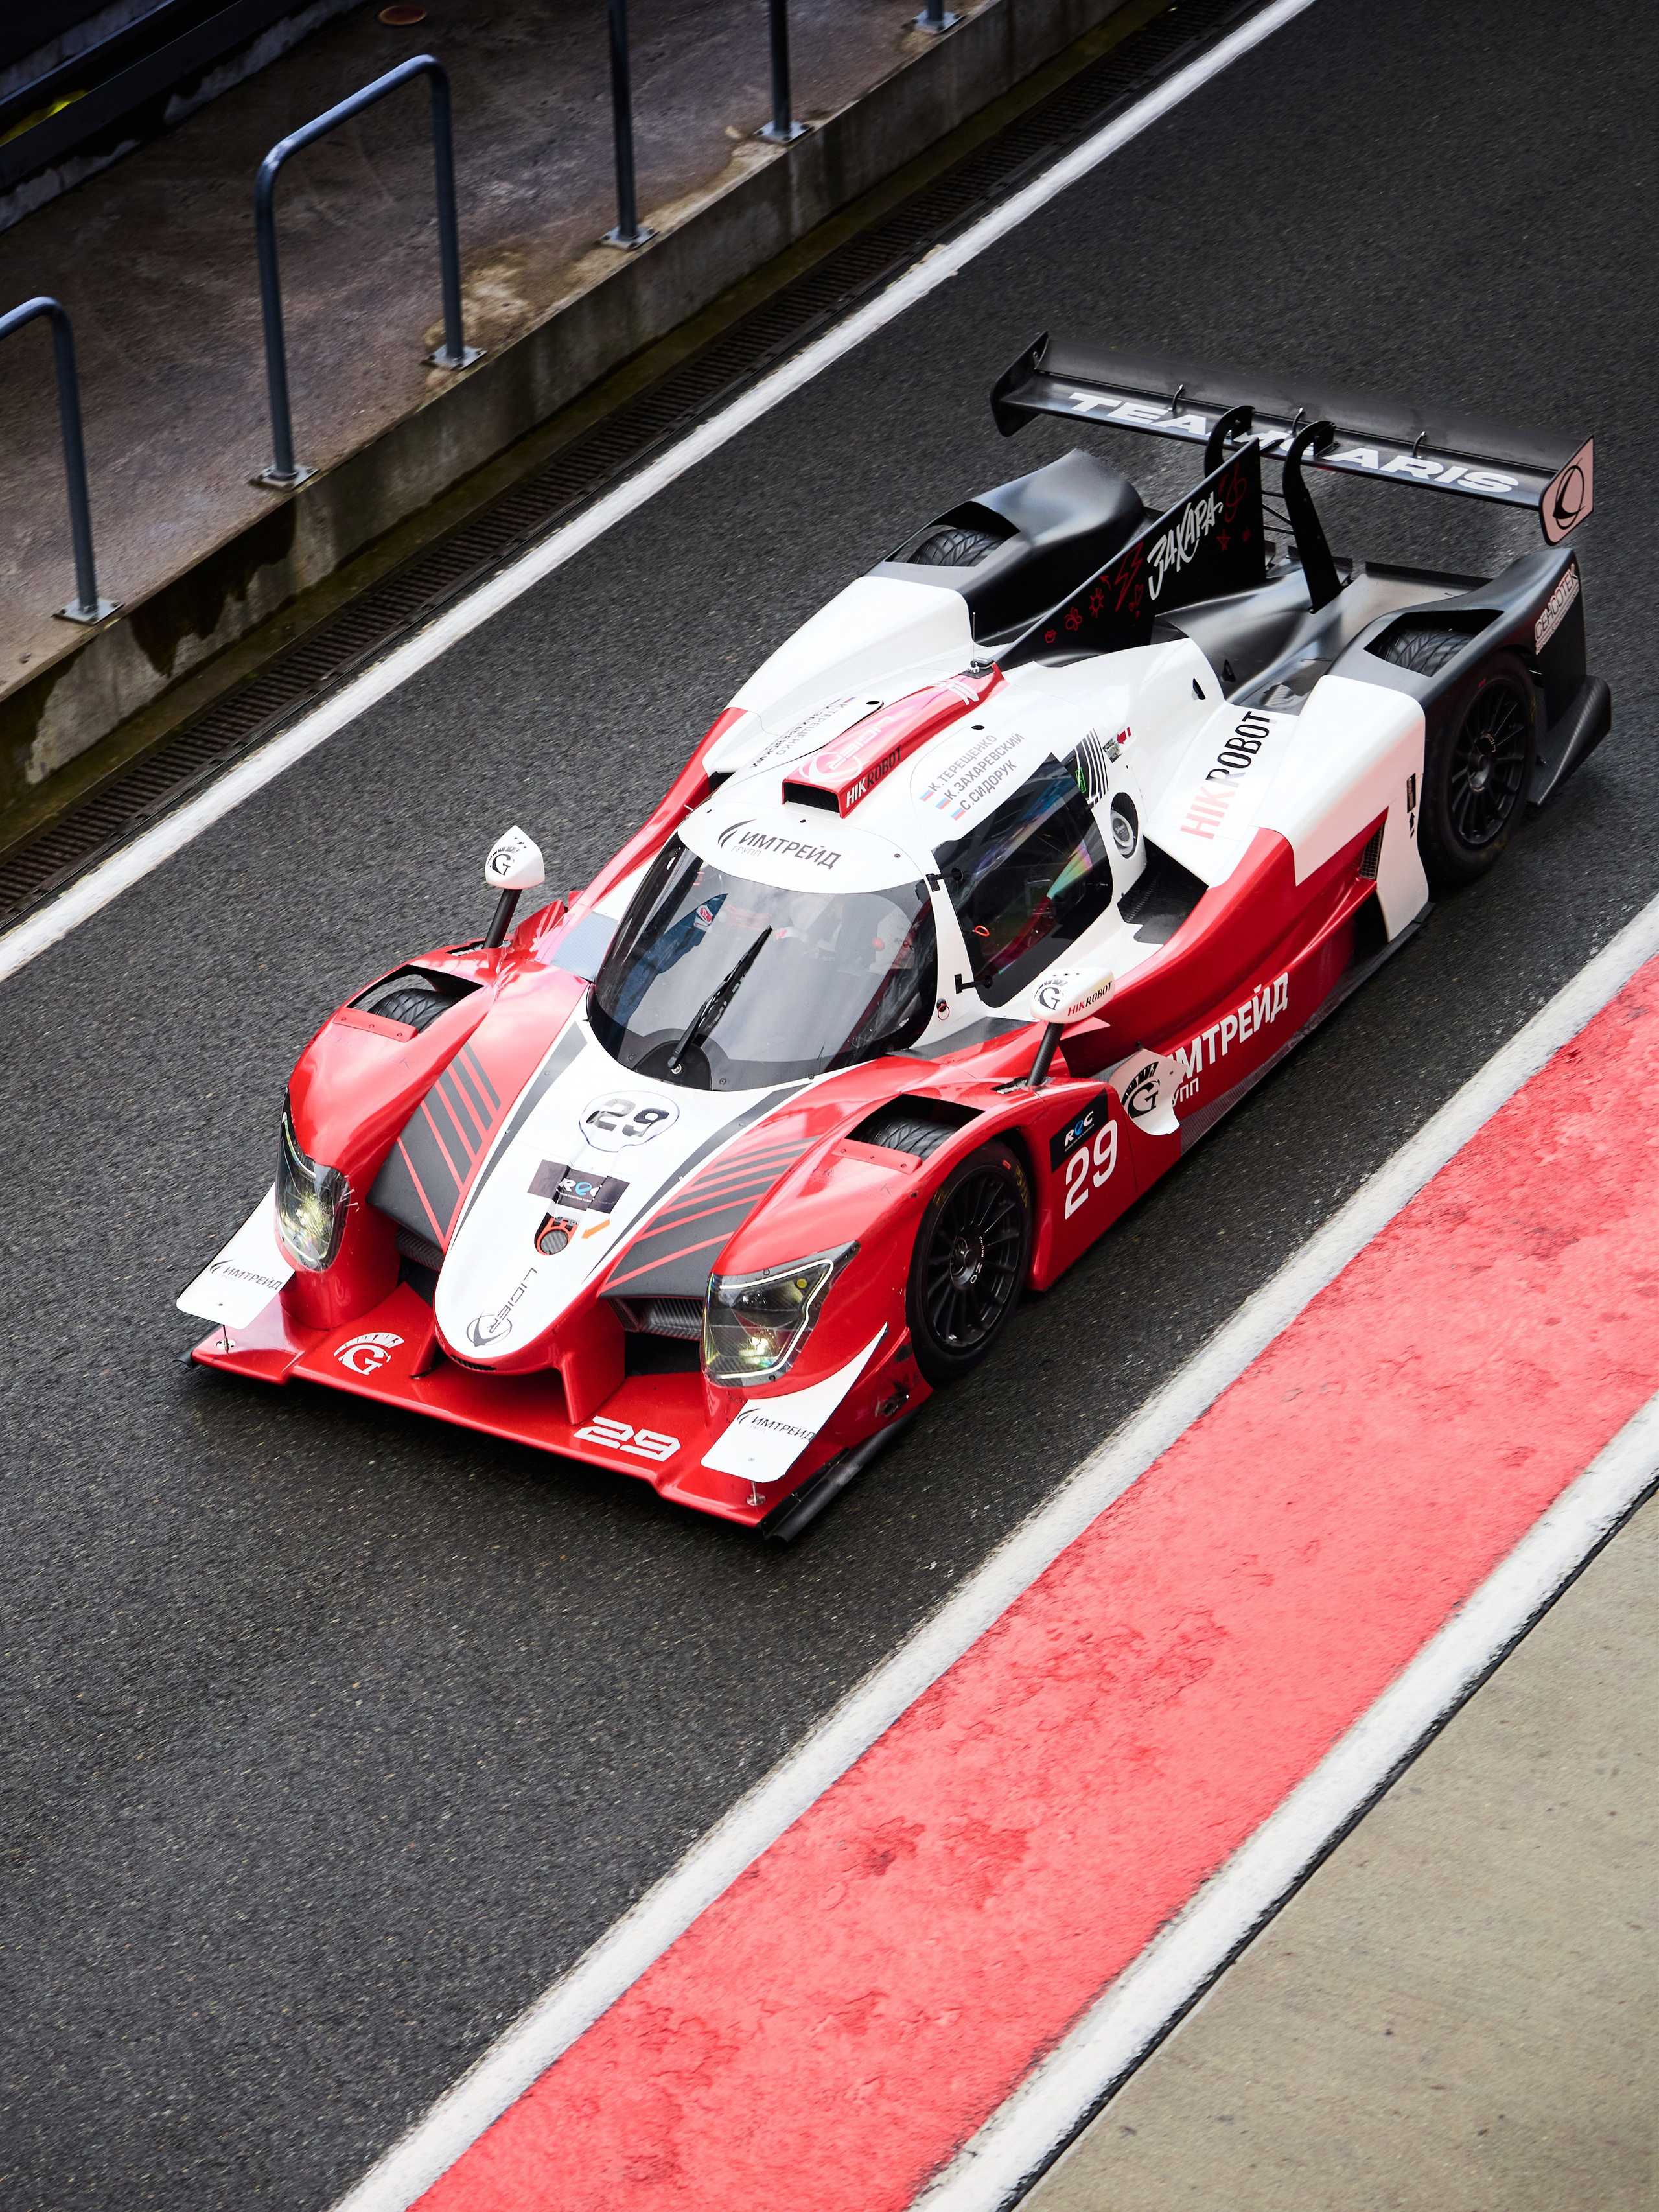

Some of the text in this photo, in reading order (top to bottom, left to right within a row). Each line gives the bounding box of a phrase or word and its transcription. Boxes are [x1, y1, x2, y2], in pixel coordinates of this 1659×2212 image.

[846, 745, 902, 808] HIKROBOT
[928, 735, 997, 792] К.ТЕРЕЩЕНКО
[944, 732, 1025, 800] К.ЗАХАРЕВСКИЙ
[960, 760, 1017, 811] С.СИДОРУК
[1180, 710, 1277, 840] HIKROBOT
[731, 845, 762, 857] ГРУПП
[738, 831, 842, 870] ИМТРЕЙД
[1067, 981, 1113, 1016] HIKROBOT
[586, 1098, 669, 1138] 29
[1065, 1119, 1118, 1220] 29
[223, 1266, 283, 1290] ИМТРЕЙД
[487, 1267, 538, 1334] LIGIER
[573, 1415, 682, 1463] 29
[751, 1415, 817, 1442] ИМТРЕЙД
